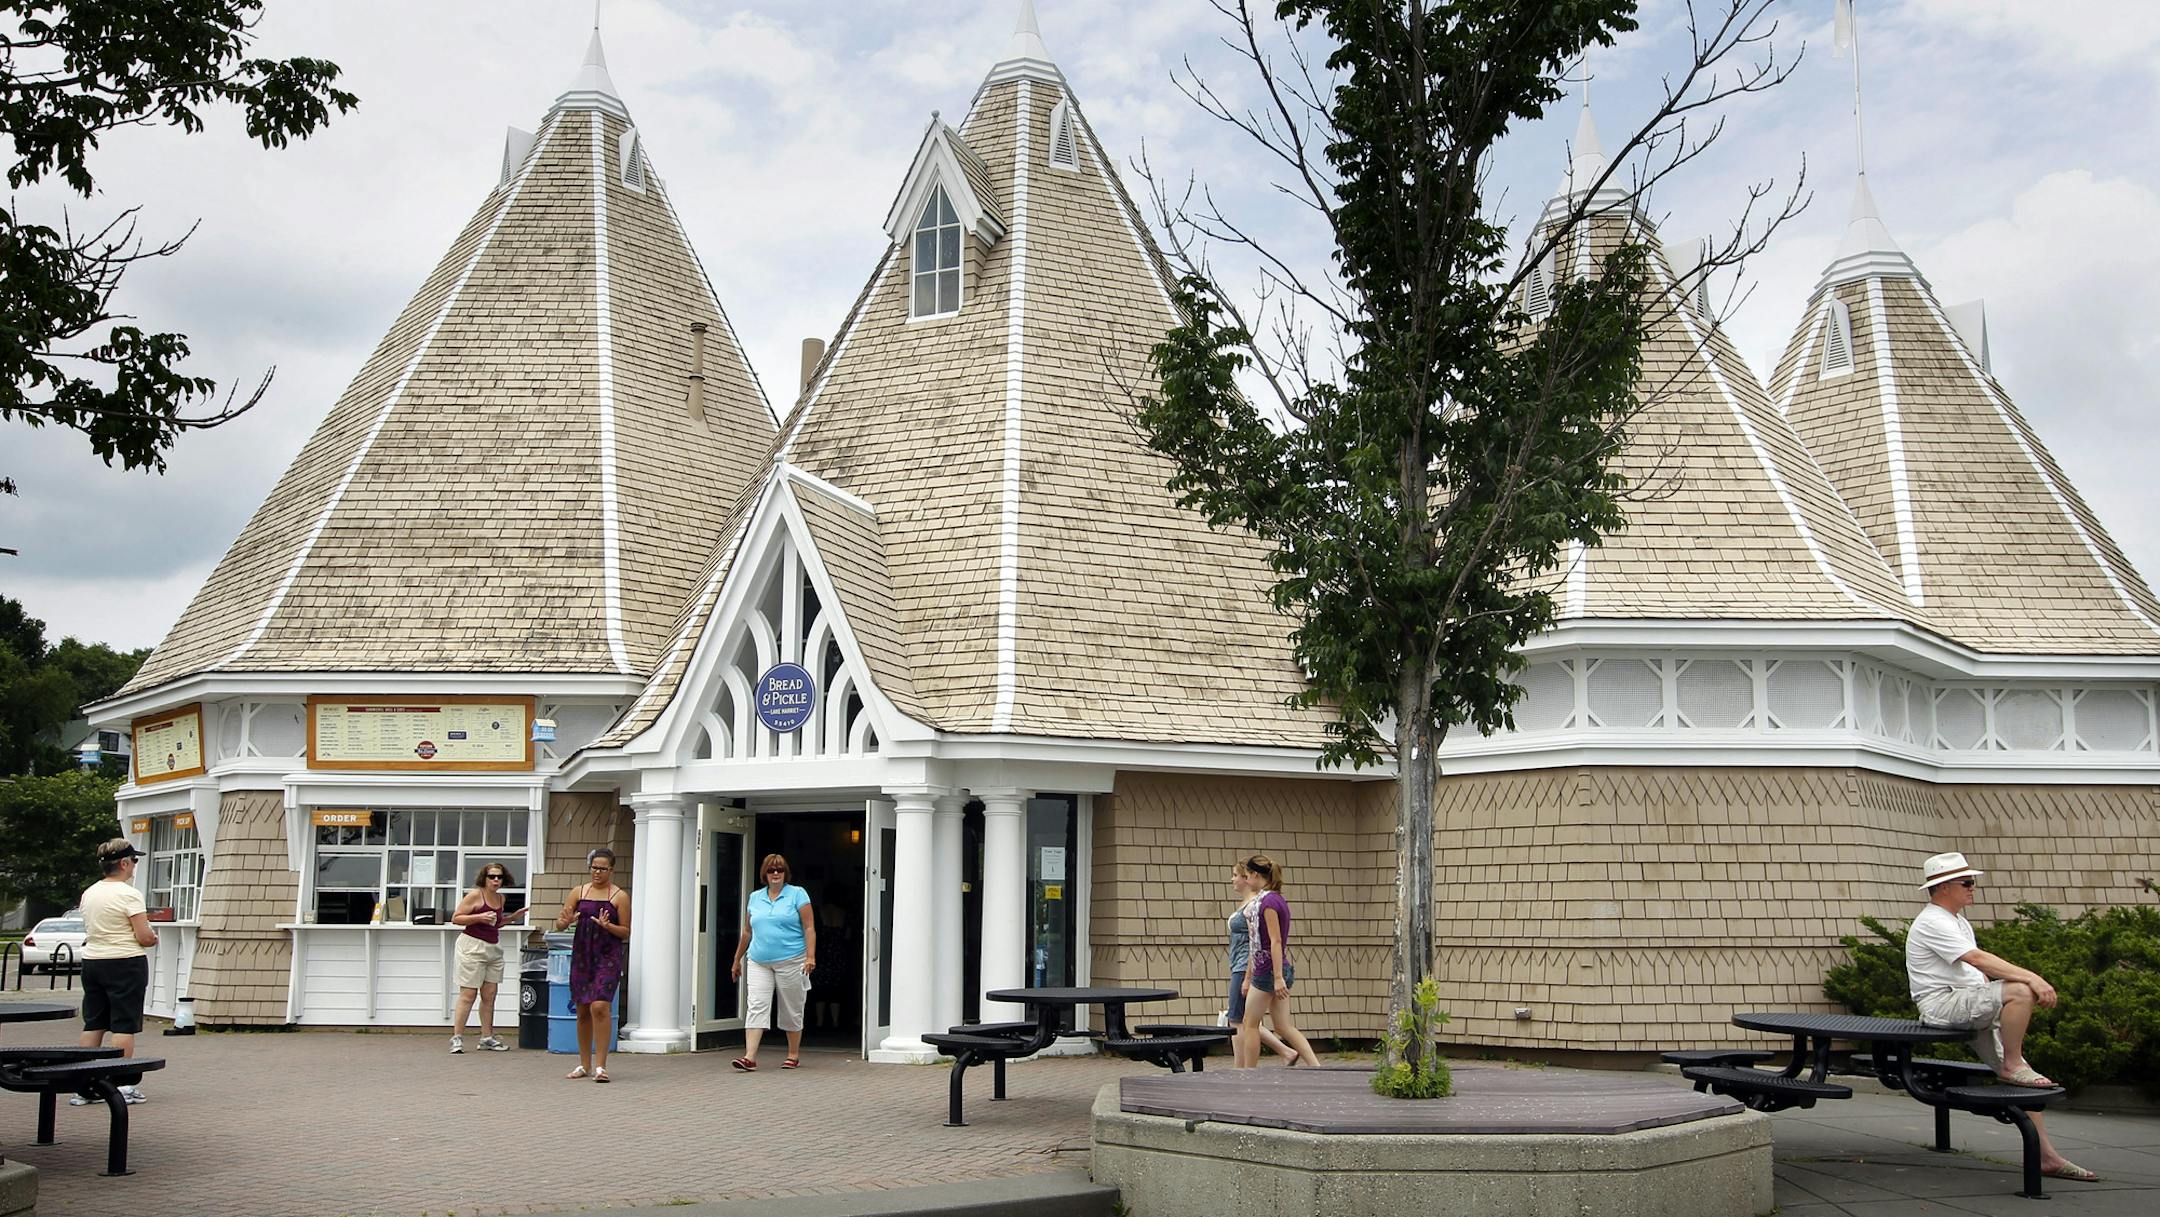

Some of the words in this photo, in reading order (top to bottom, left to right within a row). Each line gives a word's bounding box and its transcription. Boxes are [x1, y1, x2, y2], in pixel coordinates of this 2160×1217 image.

[769, 677, 803, 691] BREAD
[762, 693, 770, 706] &
[772, 692, 807, 706] PICKLE
[323, 814, 357, 822] ORDER
